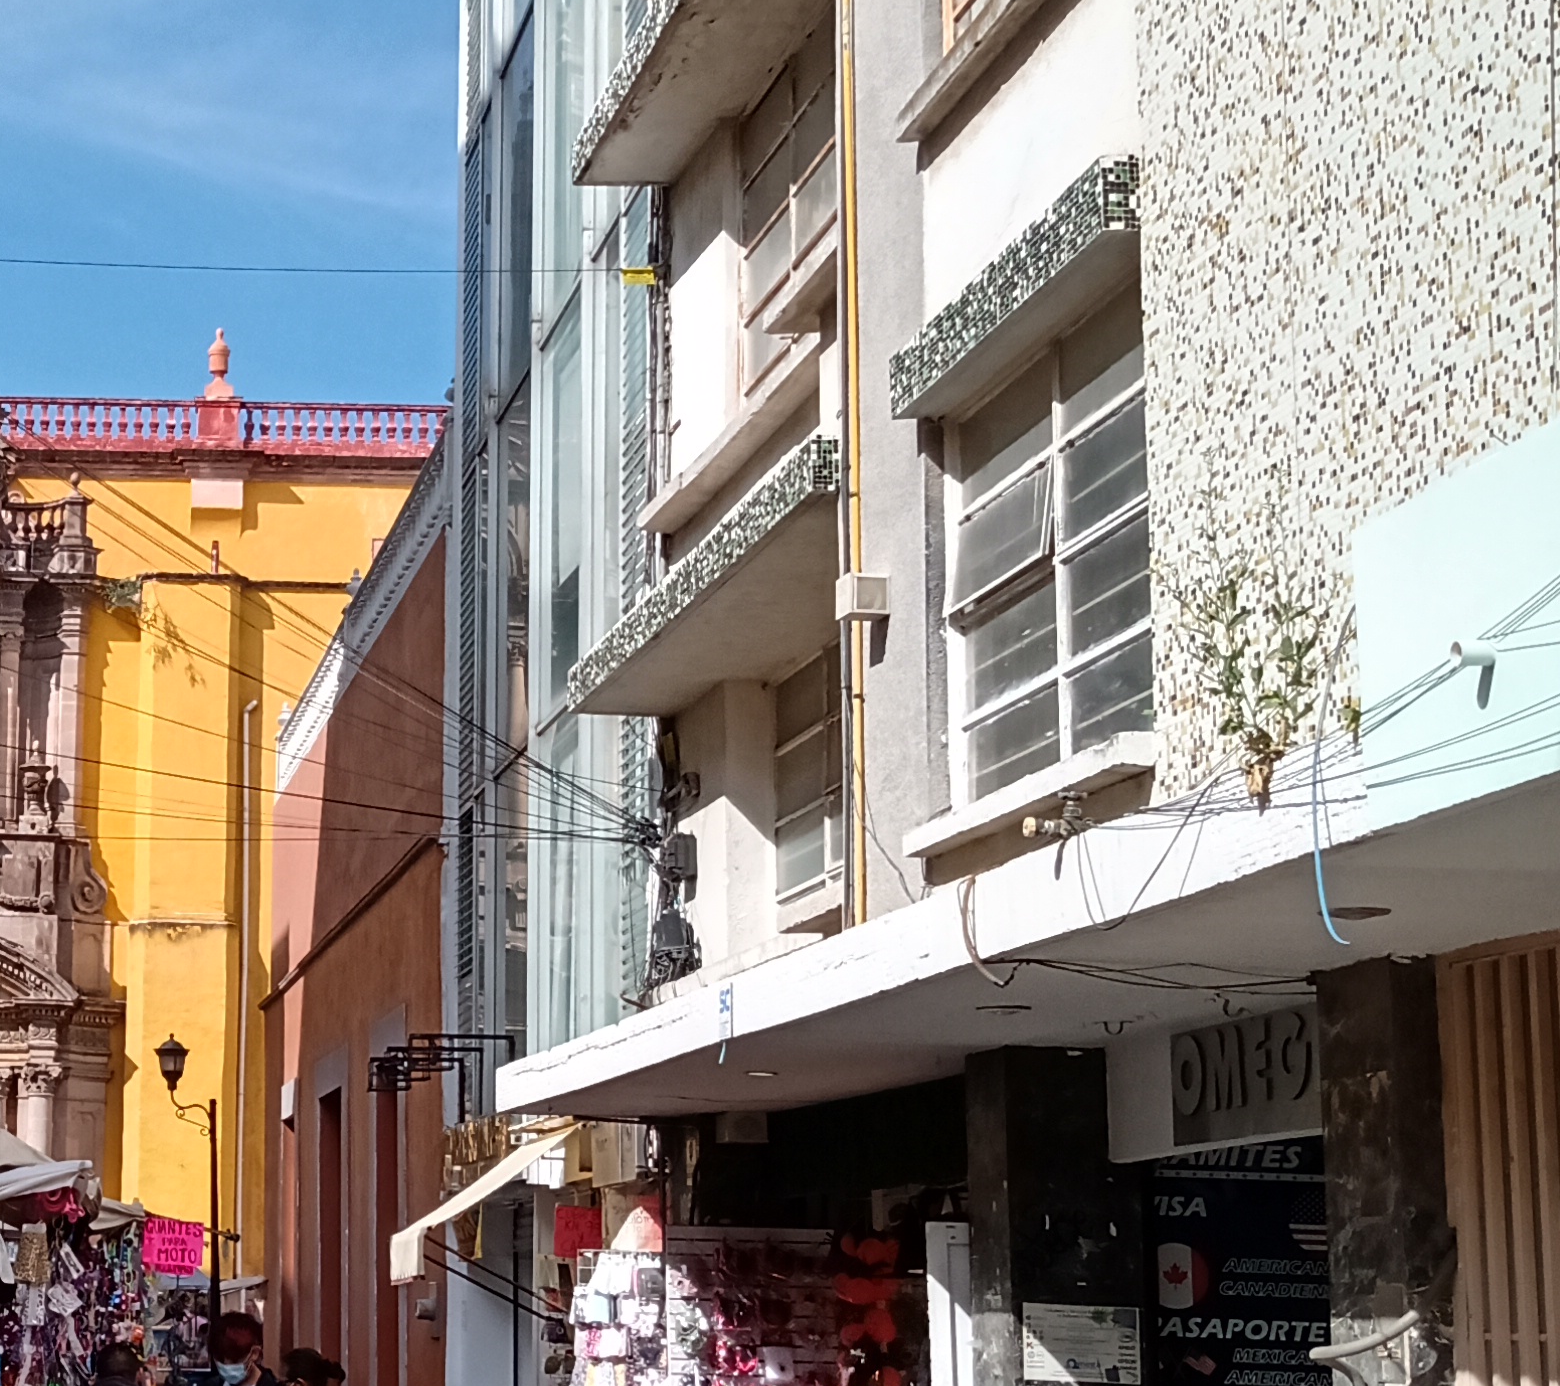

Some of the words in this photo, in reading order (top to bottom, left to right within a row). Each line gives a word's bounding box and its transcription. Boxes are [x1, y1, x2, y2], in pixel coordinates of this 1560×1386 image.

[1160, 1143, 1302, 1169] AMITES
[145, 1218, 203, 1238] GUANTES
[157, 1247, 197, 1264] MOTO
[1157, 1316, 1327, 1343] ASAPORTE
